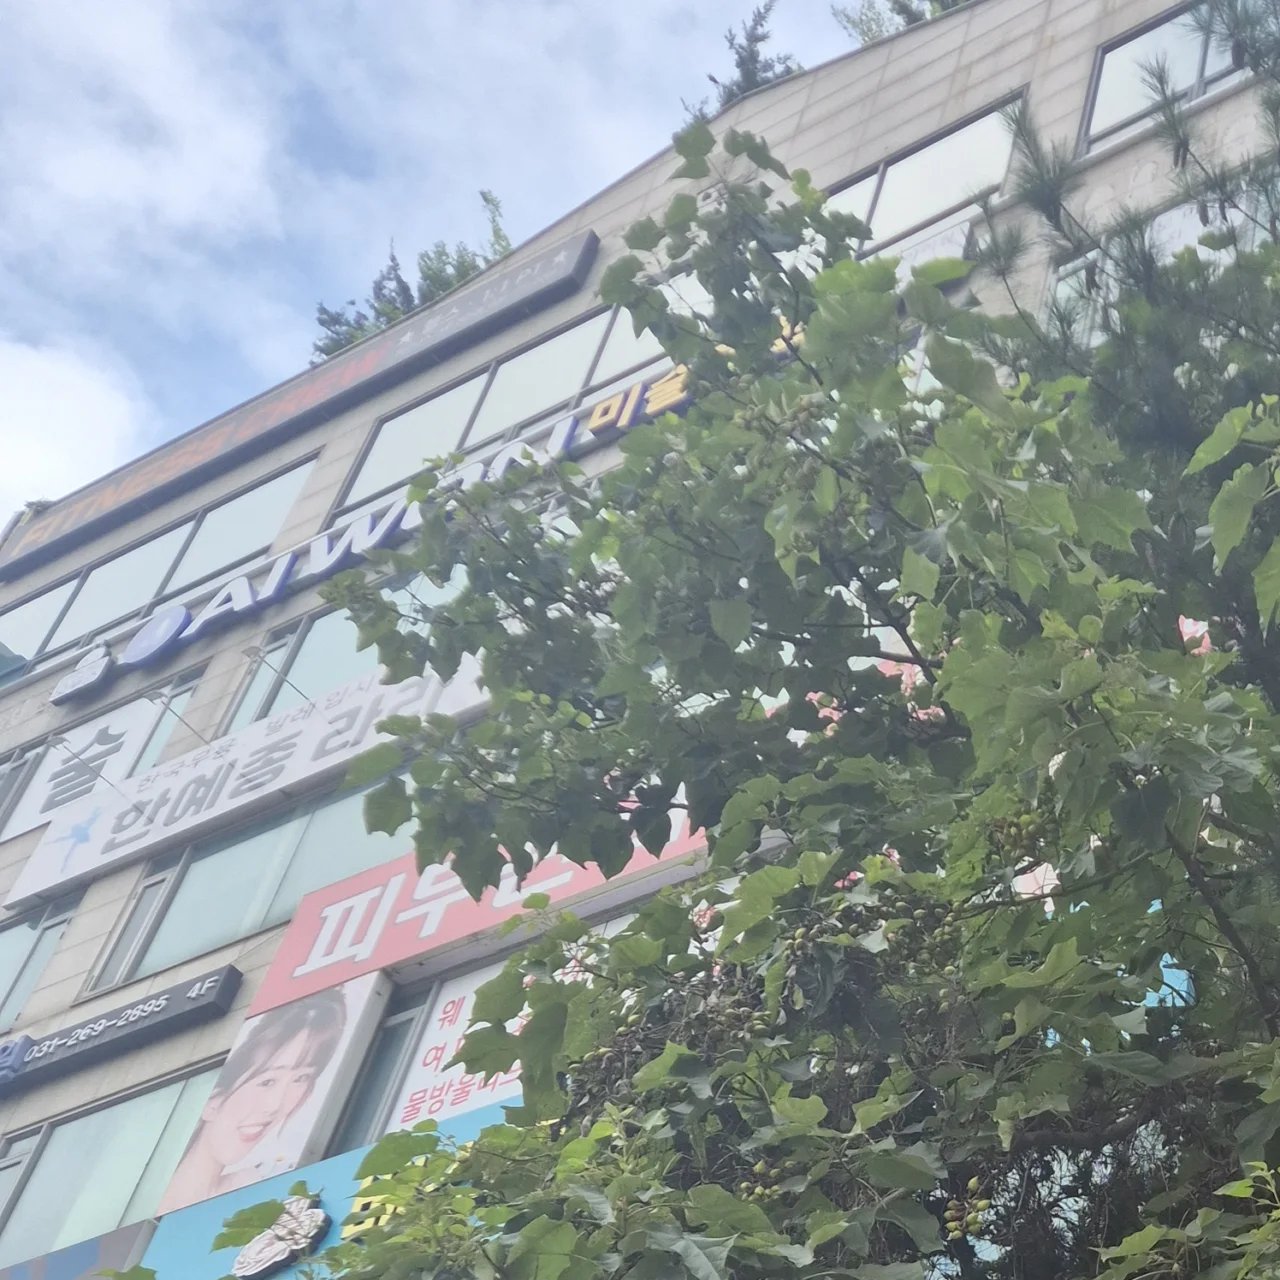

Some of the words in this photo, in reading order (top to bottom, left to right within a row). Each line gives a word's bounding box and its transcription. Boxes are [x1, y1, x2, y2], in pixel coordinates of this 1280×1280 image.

[100, 730, 303, 855] 한예종
[24, 995, 170, 1062] 031-269-2895
[186, 976, 219, 999] 4F
